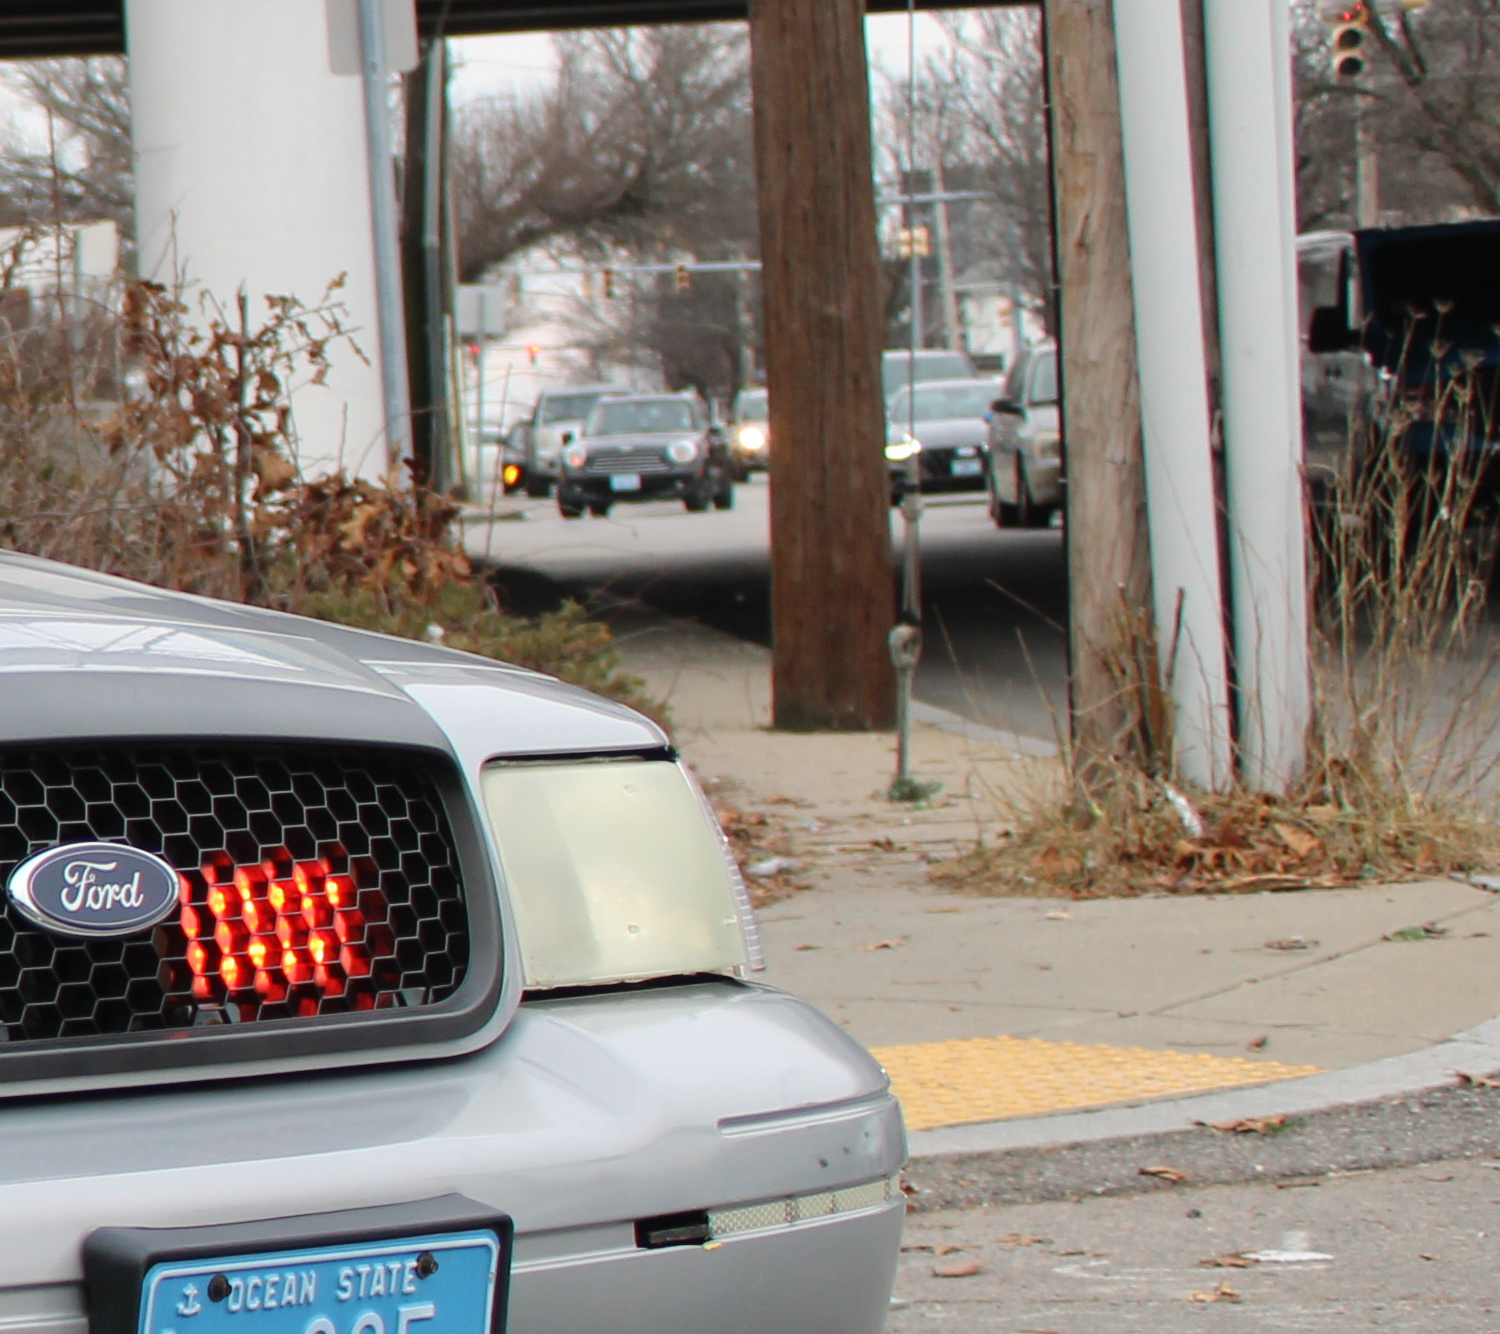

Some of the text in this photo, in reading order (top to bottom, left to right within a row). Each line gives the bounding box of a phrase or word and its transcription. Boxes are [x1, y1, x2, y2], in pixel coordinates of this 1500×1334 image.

[61, 861, 144, 911] Ford
[226, 1259, 418, 1314] OCEAN STATE
